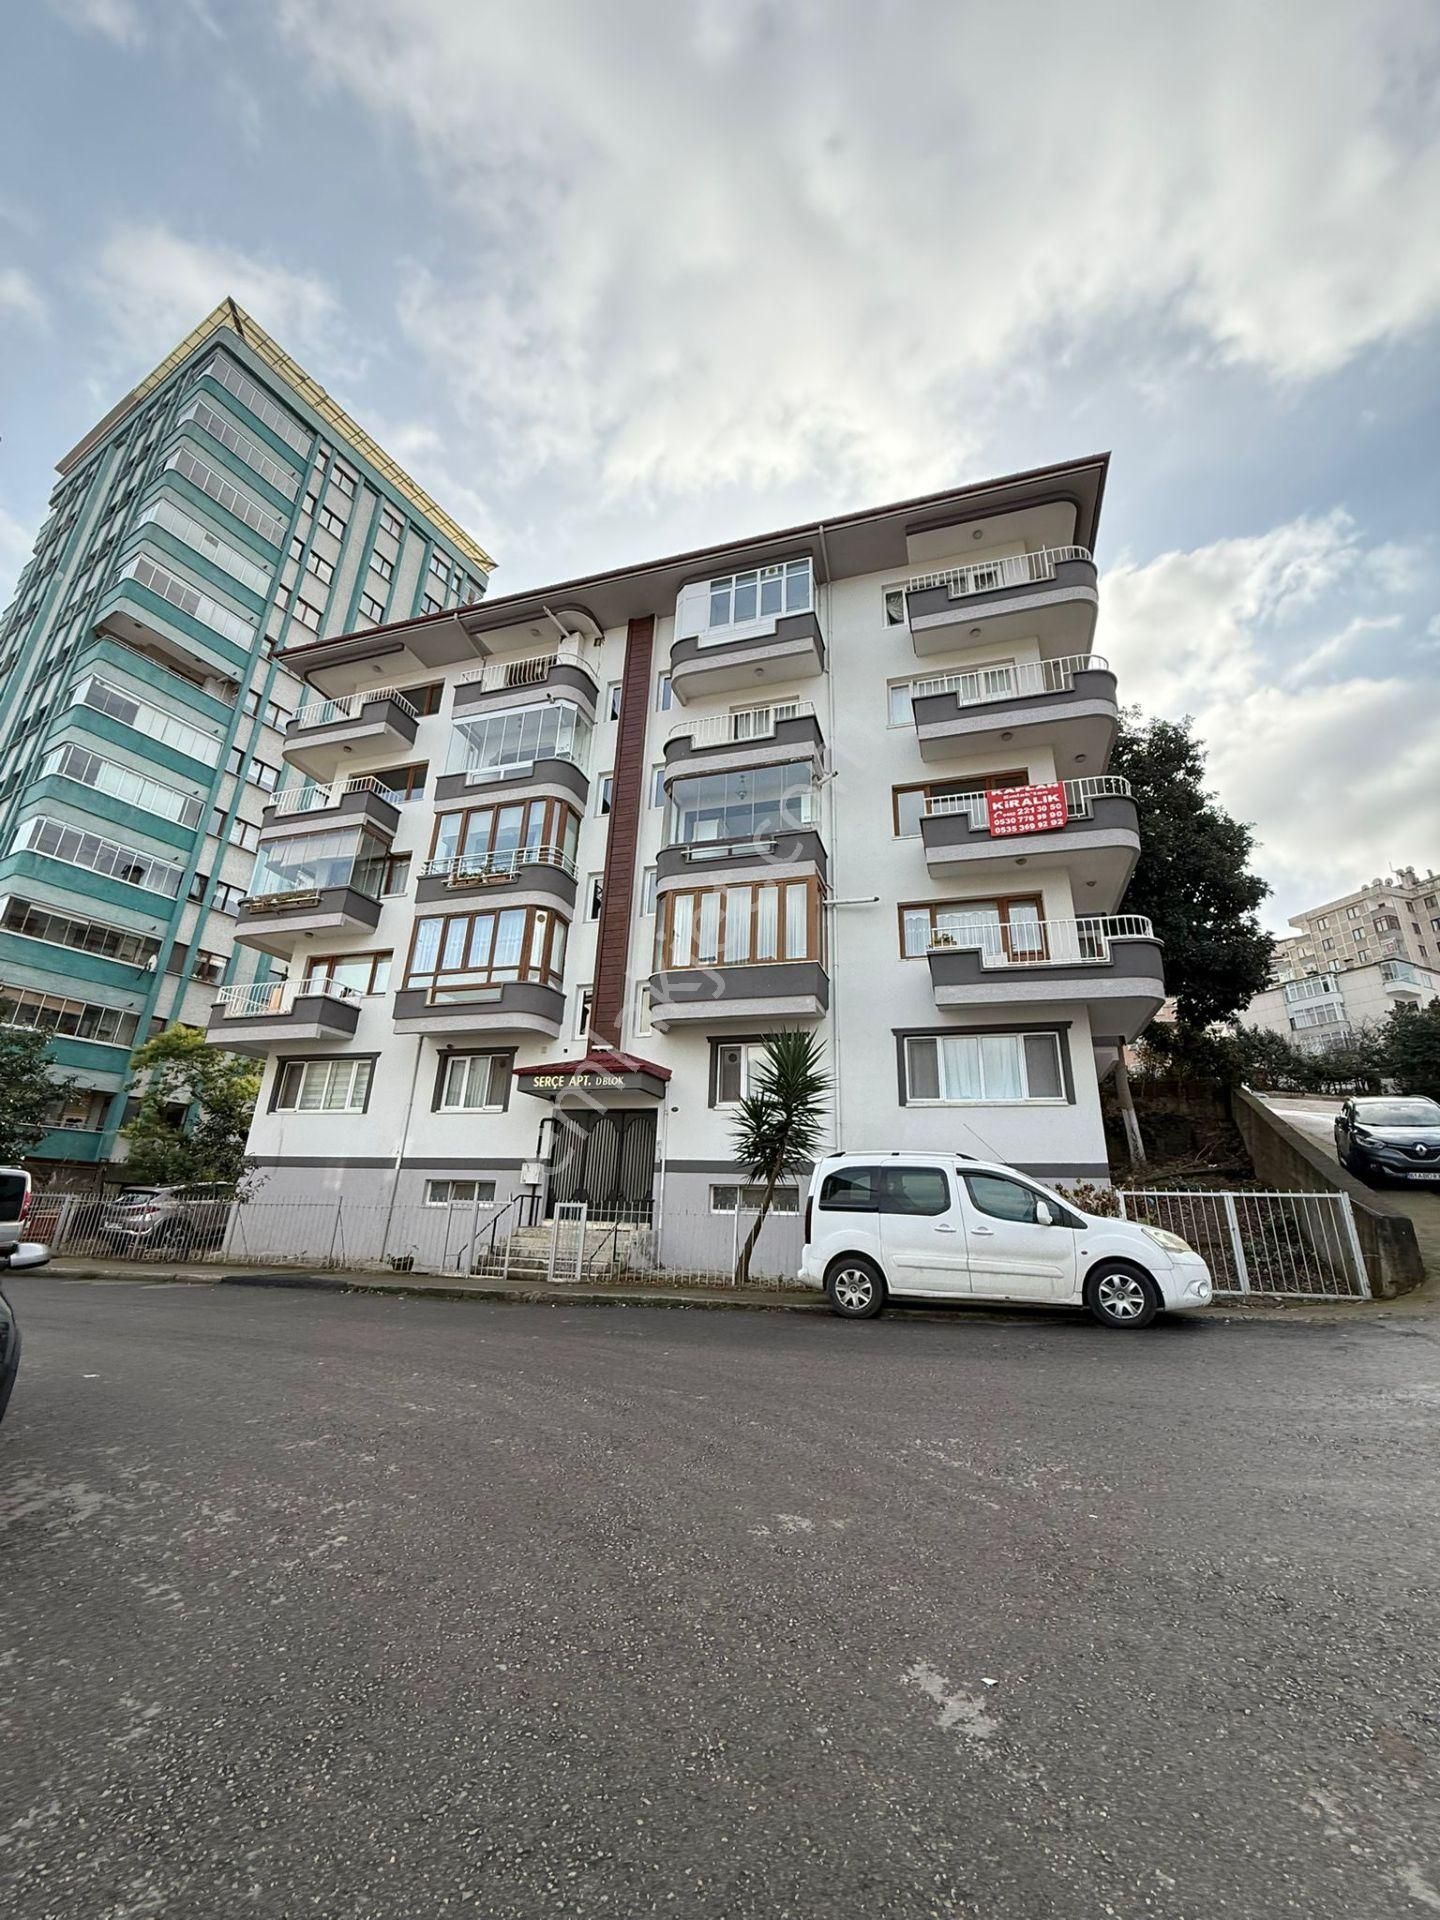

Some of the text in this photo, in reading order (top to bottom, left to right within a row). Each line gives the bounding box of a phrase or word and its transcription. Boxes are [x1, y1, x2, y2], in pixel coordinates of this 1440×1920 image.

[1017, 807, 1035, 815] 221
[1049, 802, 1062, 810] 50
[1017, 815, 1035, 823] 776
[1018, 823, 1036, 831] 369
[1050, 818, 1064, 826] 92
[533, 1076, 564, 1089] SERÇE
[568, 1074, 592, 1086] APT.
